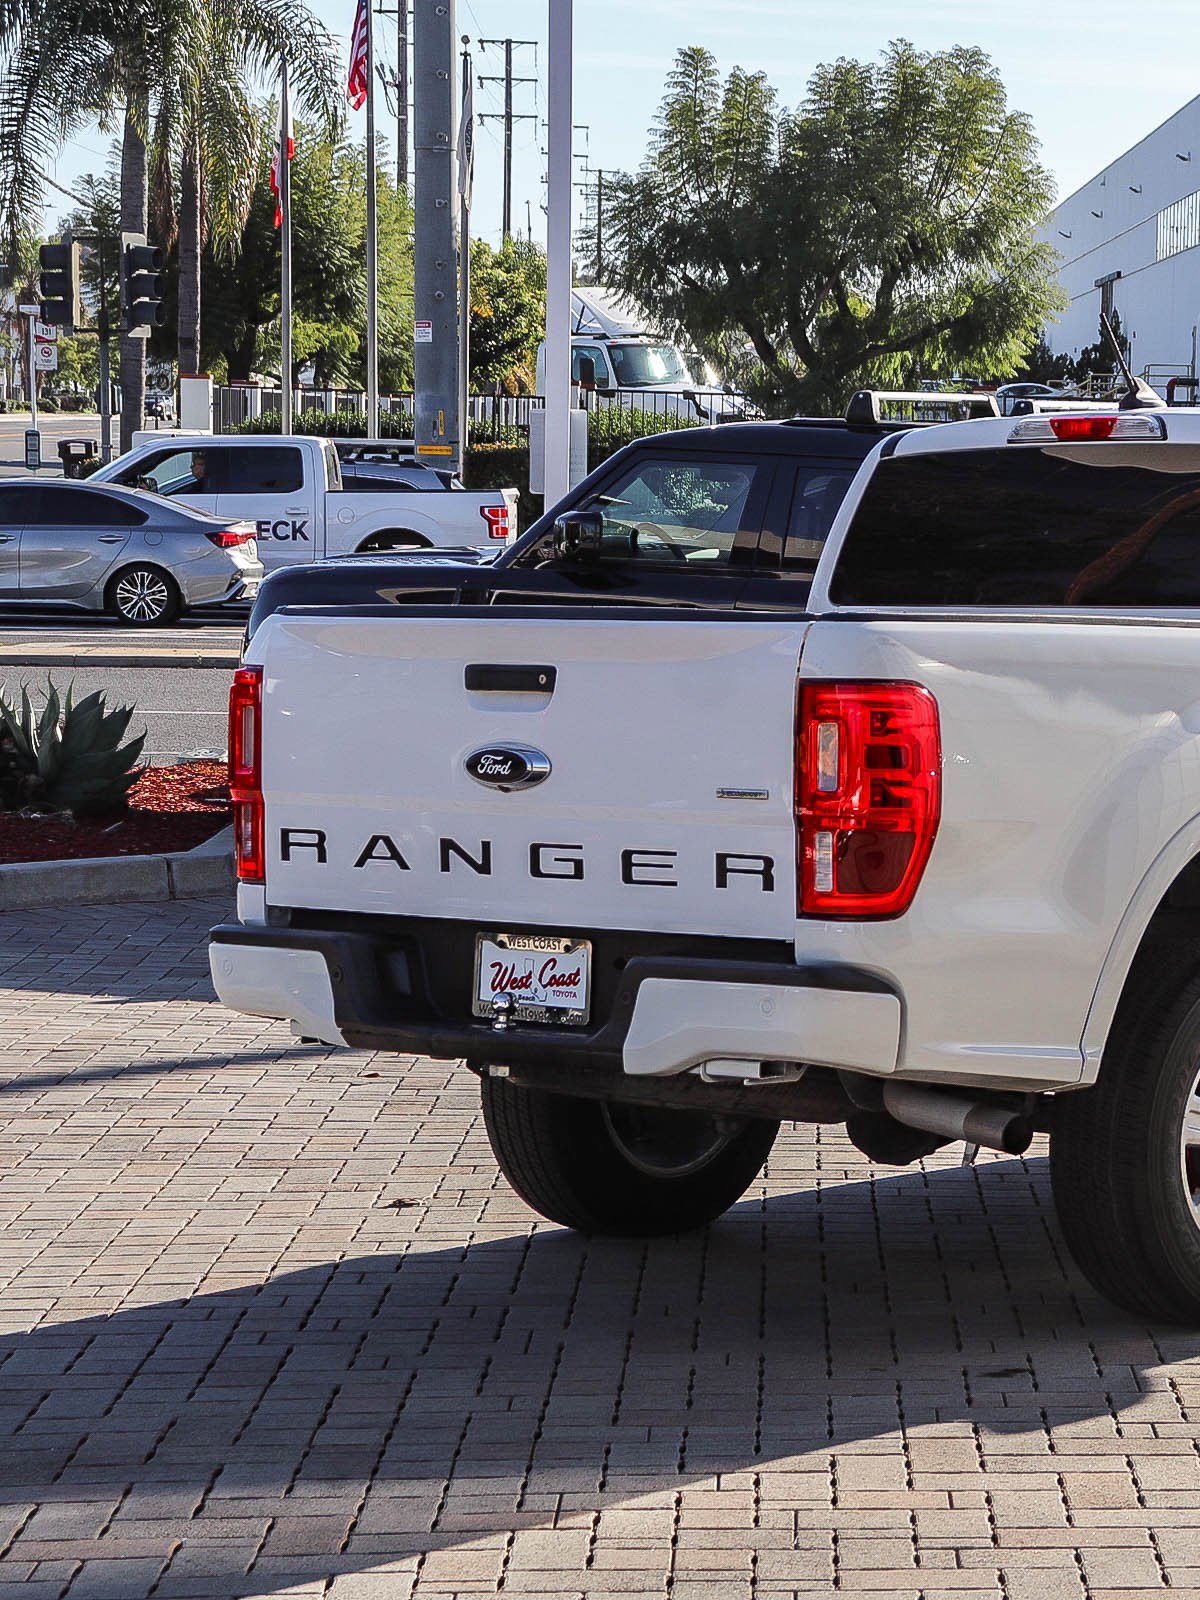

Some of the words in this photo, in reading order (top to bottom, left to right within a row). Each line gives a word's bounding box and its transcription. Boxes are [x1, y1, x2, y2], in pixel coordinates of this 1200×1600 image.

[256, 520, 310, 541] ECK
[477, 754, 512, 775] Ford
[279, 827, 776, 892] RANGER
[507, 936, 533, 948] WEST
[534, 937, 562, 951] COAST
[489, 961, 533, 992] West
[538, 957, 581, 989] Coast
[552, 989, 578, 999] TOYOTA
